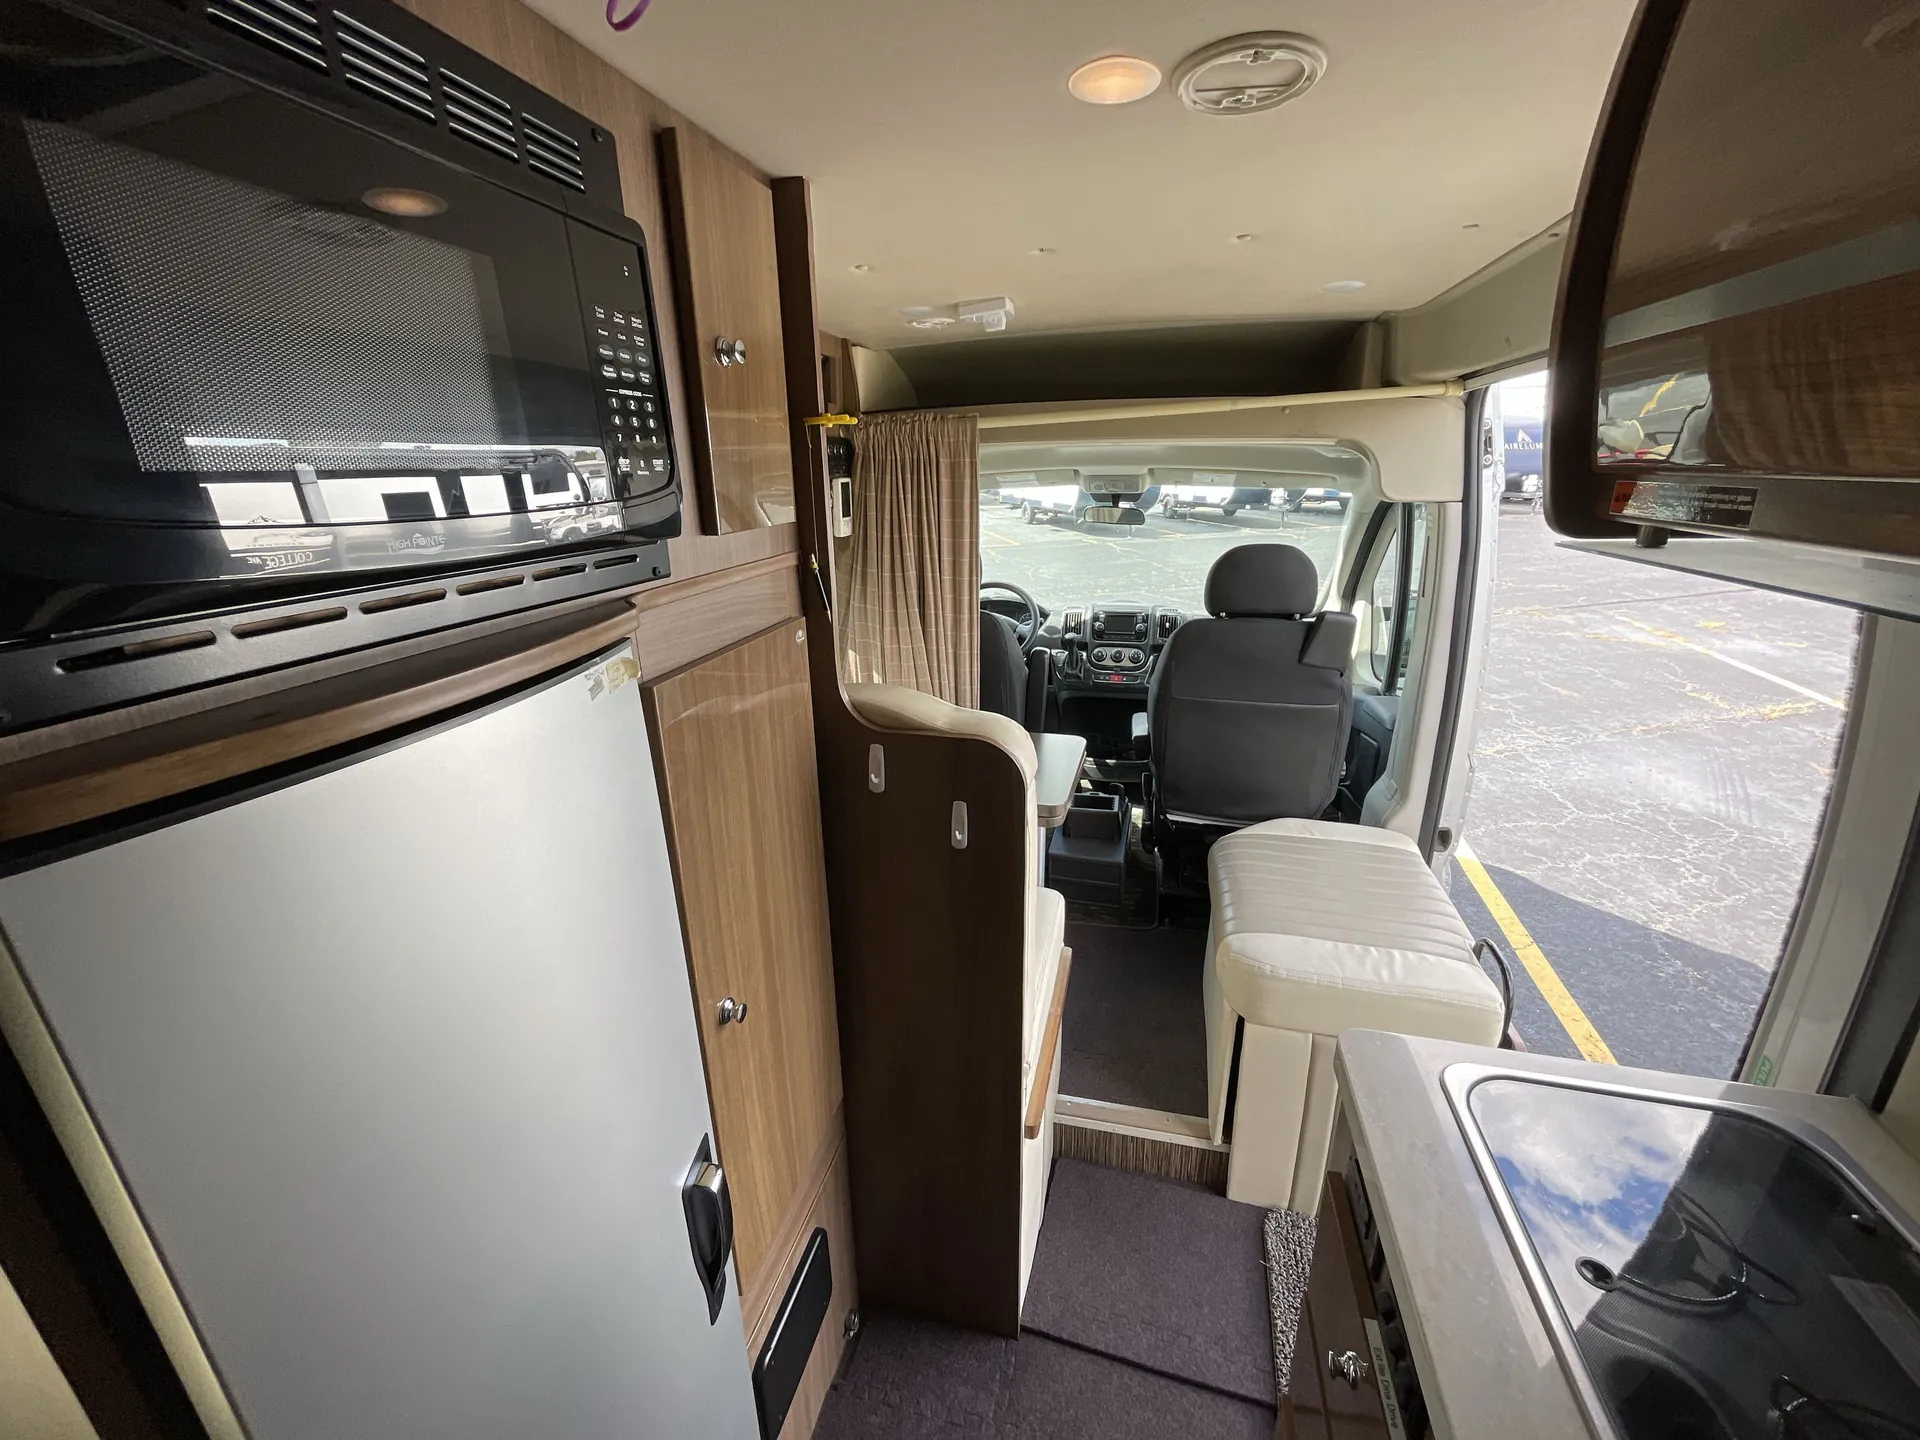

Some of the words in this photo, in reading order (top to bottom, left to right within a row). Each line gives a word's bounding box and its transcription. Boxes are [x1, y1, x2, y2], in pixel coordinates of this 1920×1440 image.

[611, 397, 617, 408] 1
[629, 400, 636, 410] 2
[646, 402, 652, 412] 3
[614, 415, 620, 425] 4
[632, 417, 638, 427] 5
[649, 418, 655, 428] 6
[617, 433, 622, 443] 7
[635, 434, 640, 443] 8
[651, 435, 657, 444] 9
[387, 538, 411, 554] HIGH
[412, 532, 448, 548] POINTE
